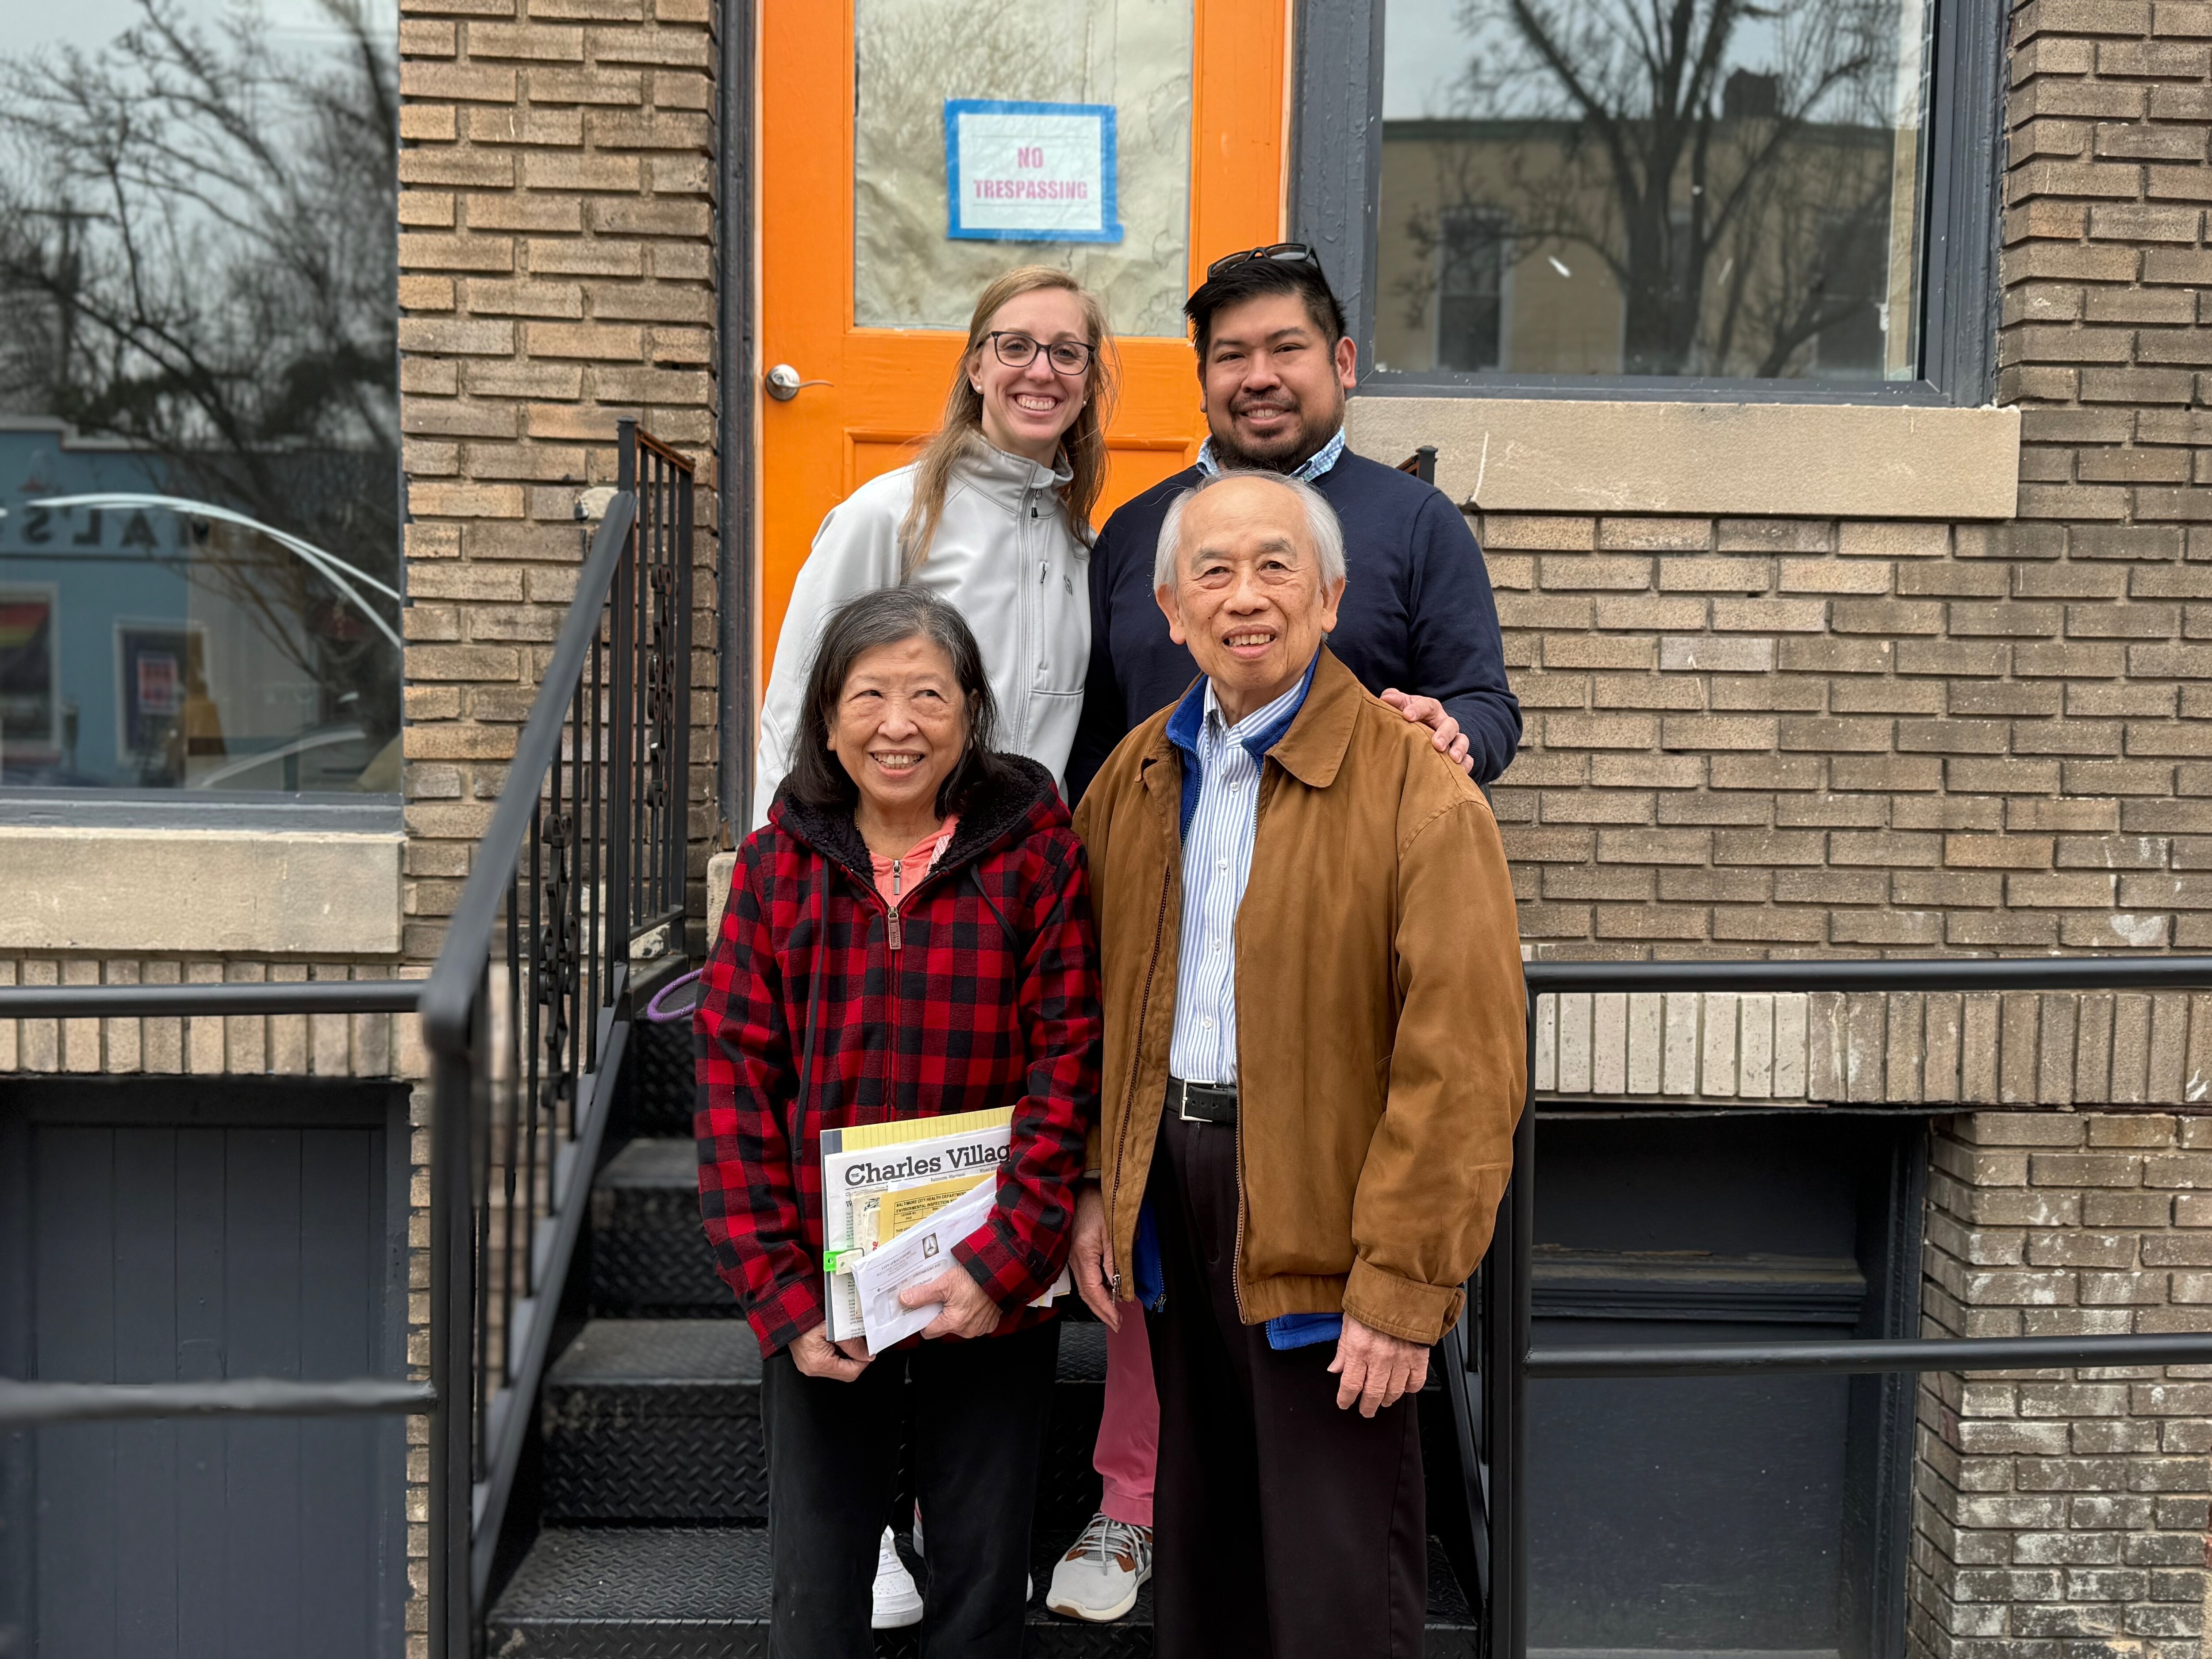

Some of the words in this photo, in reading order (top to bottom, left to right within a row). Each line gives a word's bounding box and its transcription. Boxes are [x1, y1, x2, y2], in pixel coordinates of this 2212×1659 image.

[1017, 147, 1044, 169] NO
[973, 180, 1088, 199] TRESPASSING
[845, 1156, 941, 1187] Charles
[941, 1191, 967, 1199] DEPARTMENT
[896, 1203, 926, 1213] ENVIRONMENTAL
